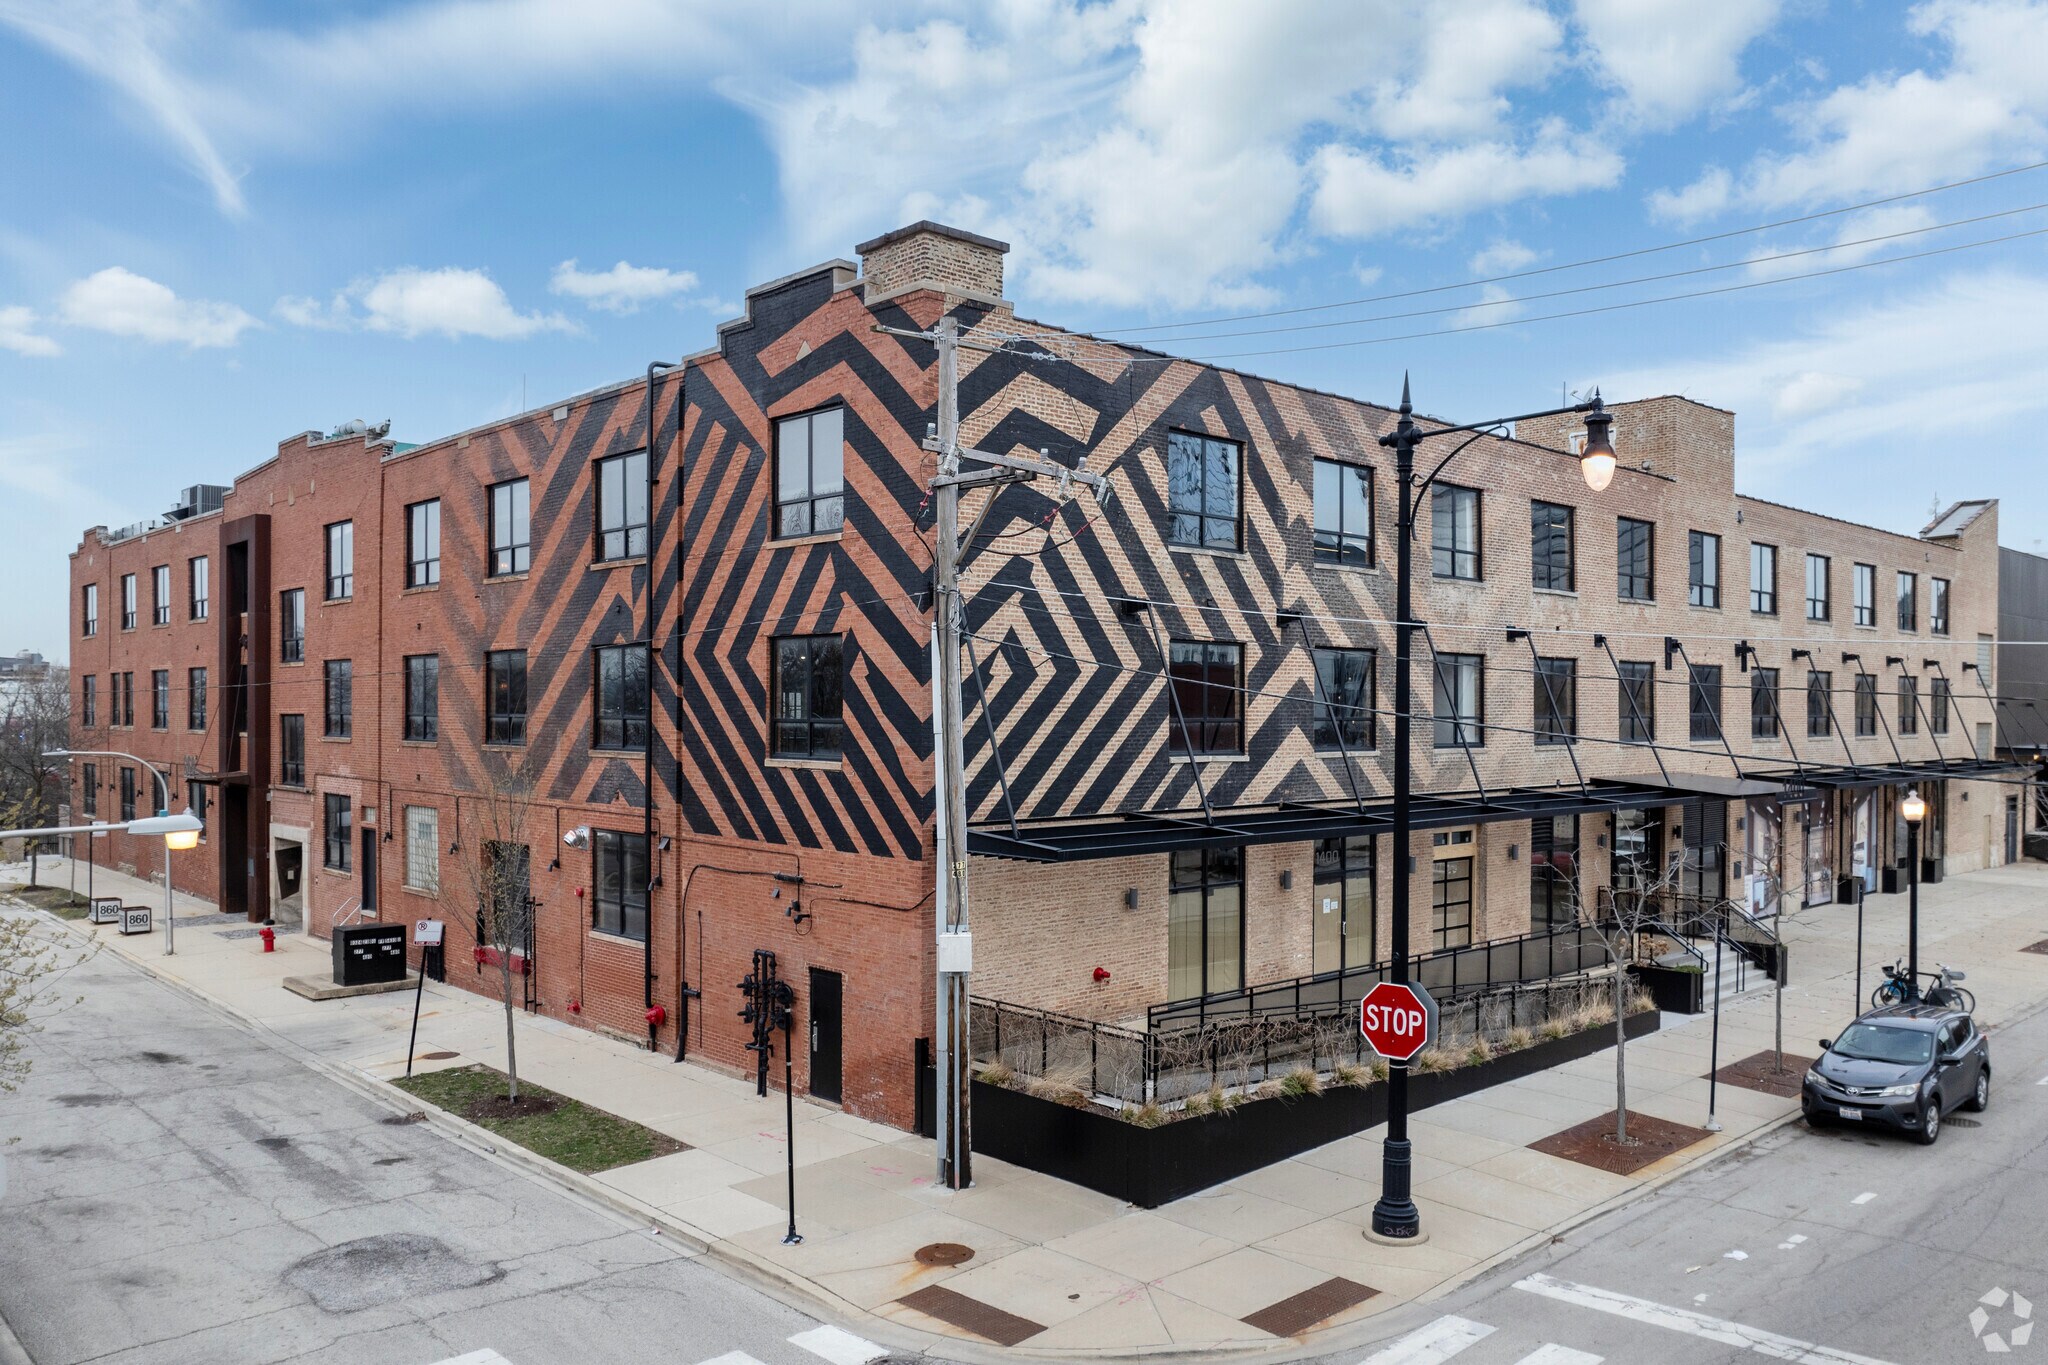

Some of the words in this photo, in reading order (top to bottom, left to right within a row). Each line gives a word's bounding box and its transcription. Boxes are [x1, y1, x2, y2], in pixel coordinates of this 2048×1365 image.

[1316, 850, 1339, 864] 1400
[100, 905, 119, 915] 860
[129, 914, 149, 924] 860
[1366, 1004, 1422, 1037] STOP
